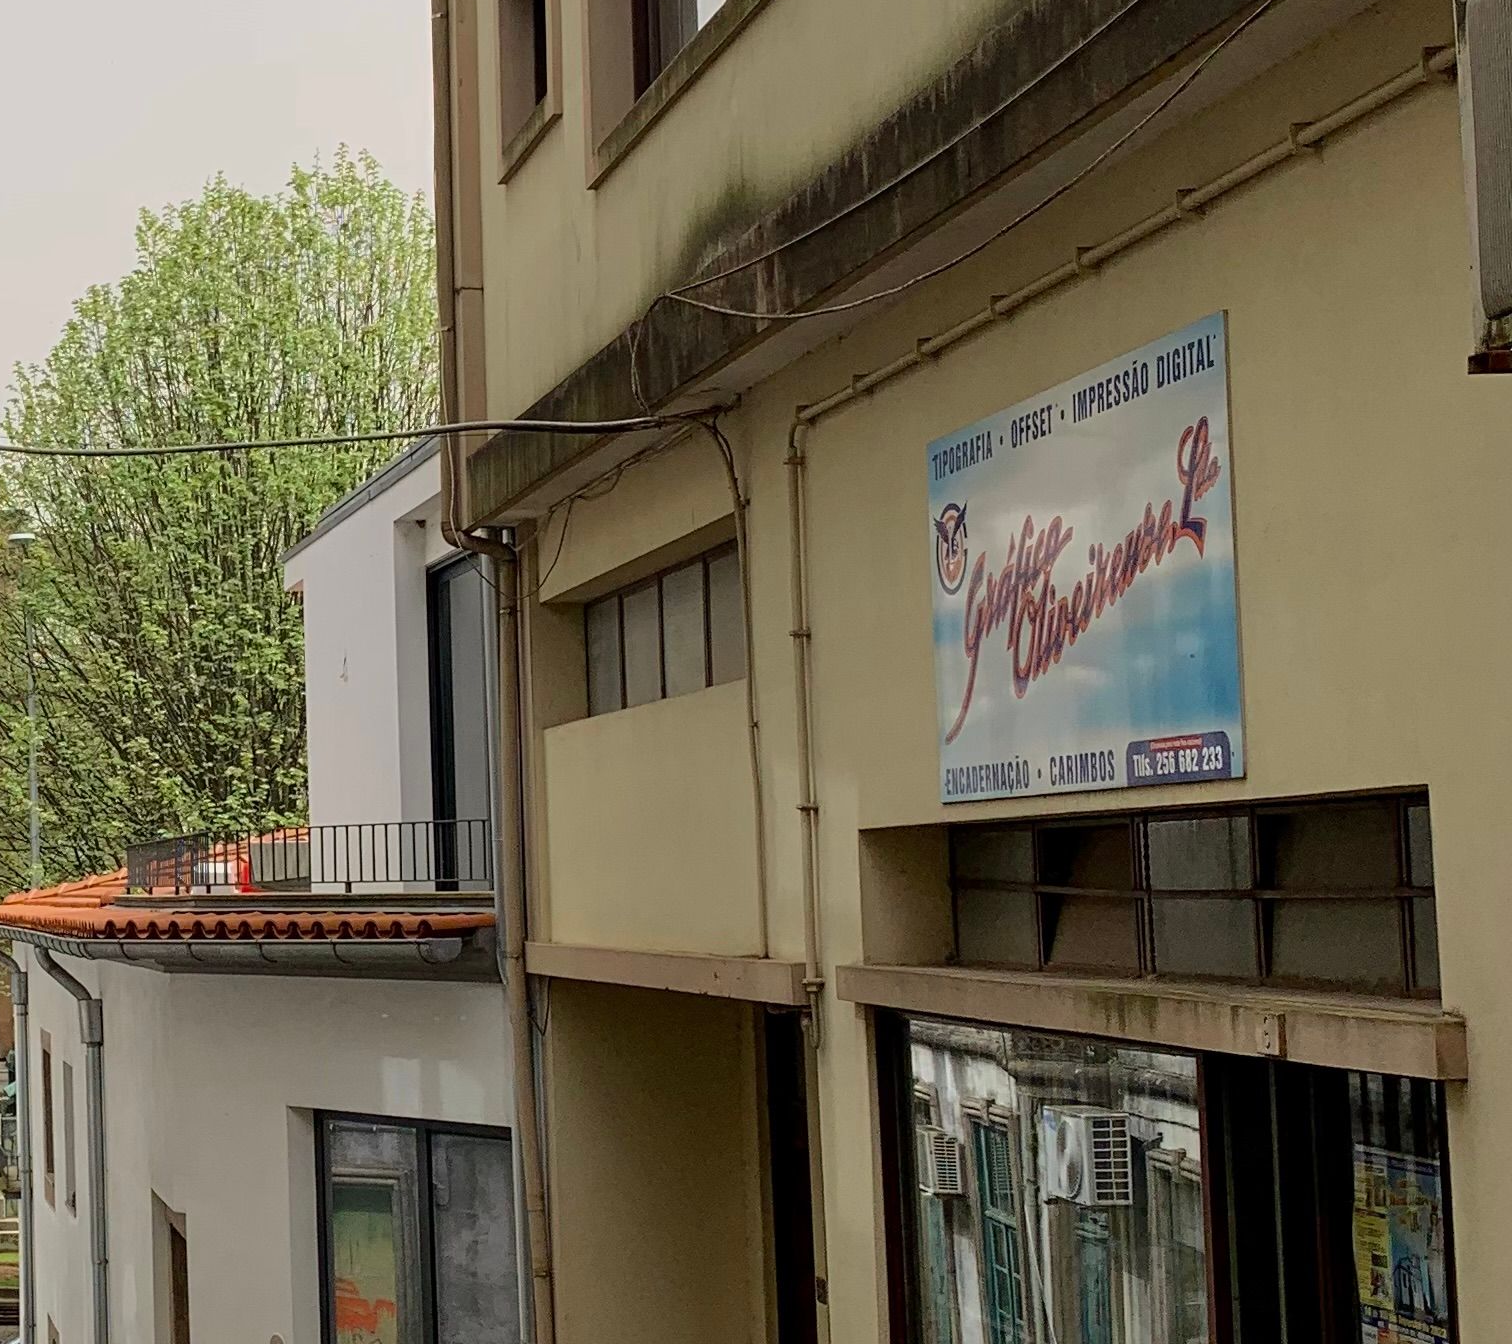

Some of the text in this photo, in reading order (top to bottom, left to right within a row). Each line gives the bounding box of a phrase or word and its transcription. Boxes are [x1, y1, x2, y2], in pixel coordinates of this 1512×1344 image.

[932, 336, 1215, 481] TIPOGRAFIA OFFSET IMPRESSÃO DIGITAL
[945, 515, 1074, 745] Gráfica
[945, 749, 1115, 795] ENCADERNAÇÃO CARIMBOS
[1156, 751, 1176, 775] 256
[1178, 748, 1199, 773] 682
[1202, 745, 1223, 771] 233
